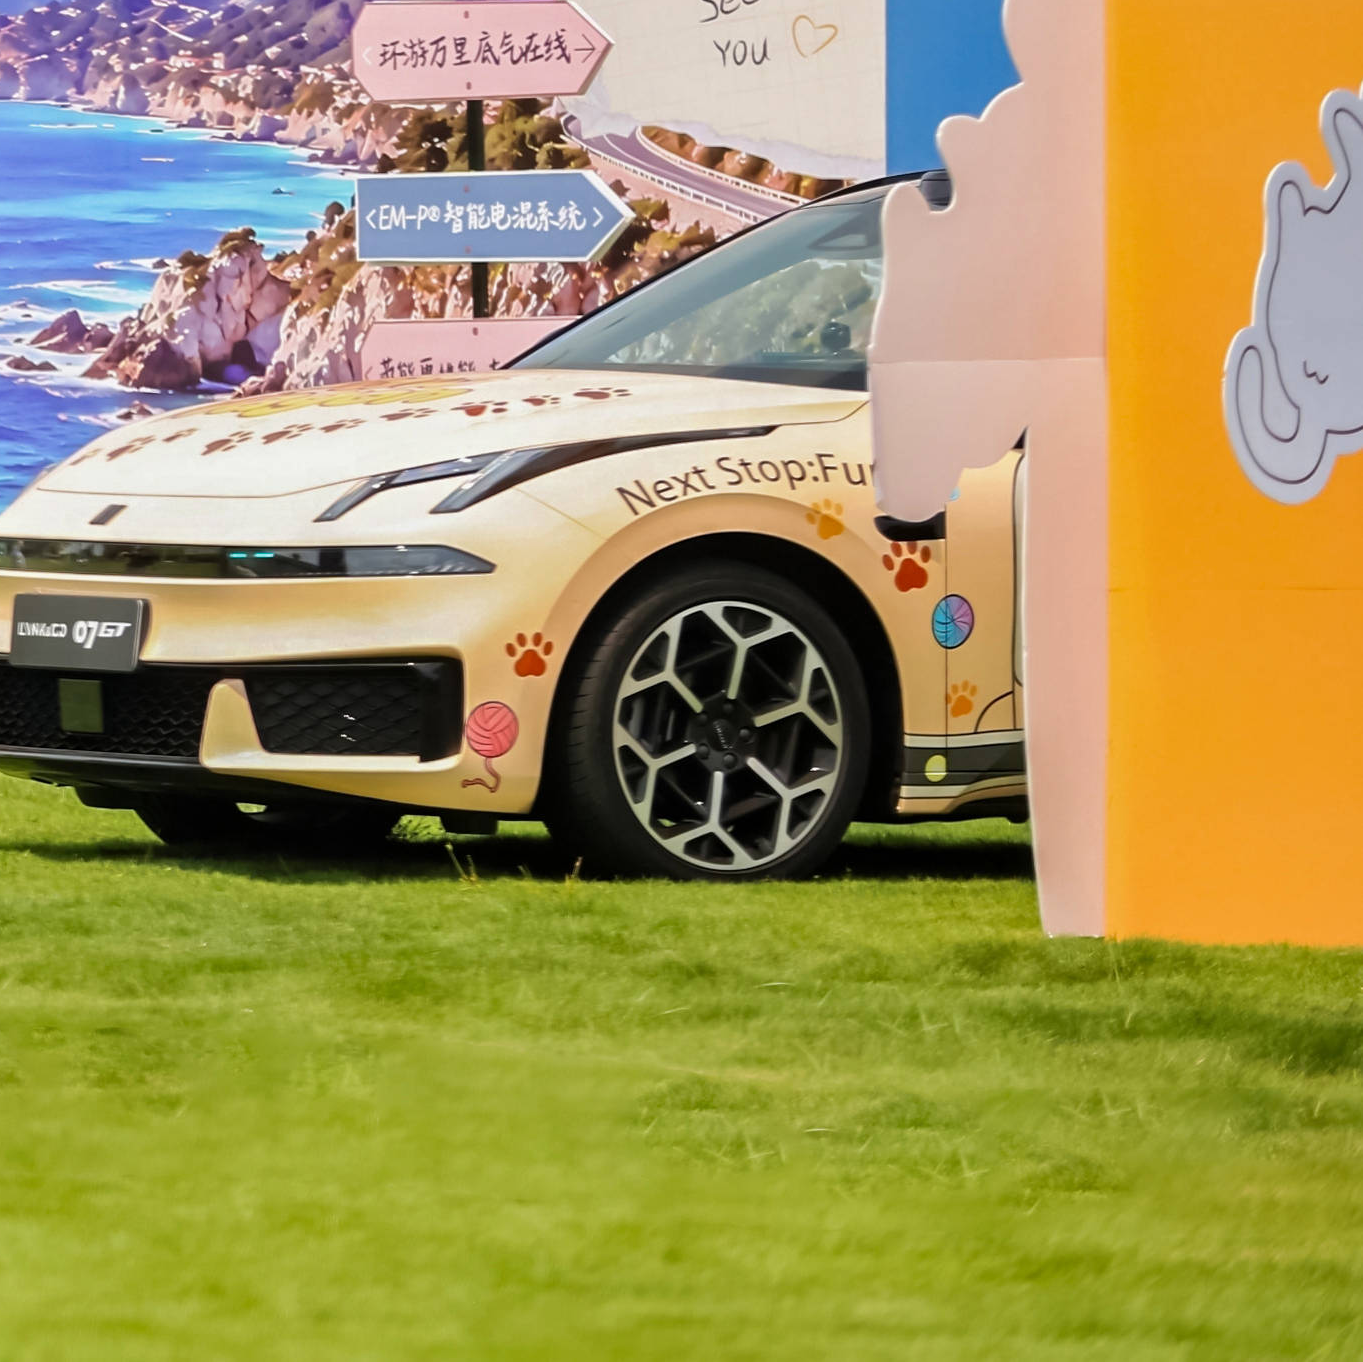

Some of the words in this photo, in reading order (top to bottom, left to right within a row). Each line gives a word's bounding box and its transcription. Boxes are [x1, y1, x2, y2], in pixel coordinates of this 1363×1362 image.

[378, 28, 572, 70] 环游万里底气在线
[616, 466, 716, 516] Next
